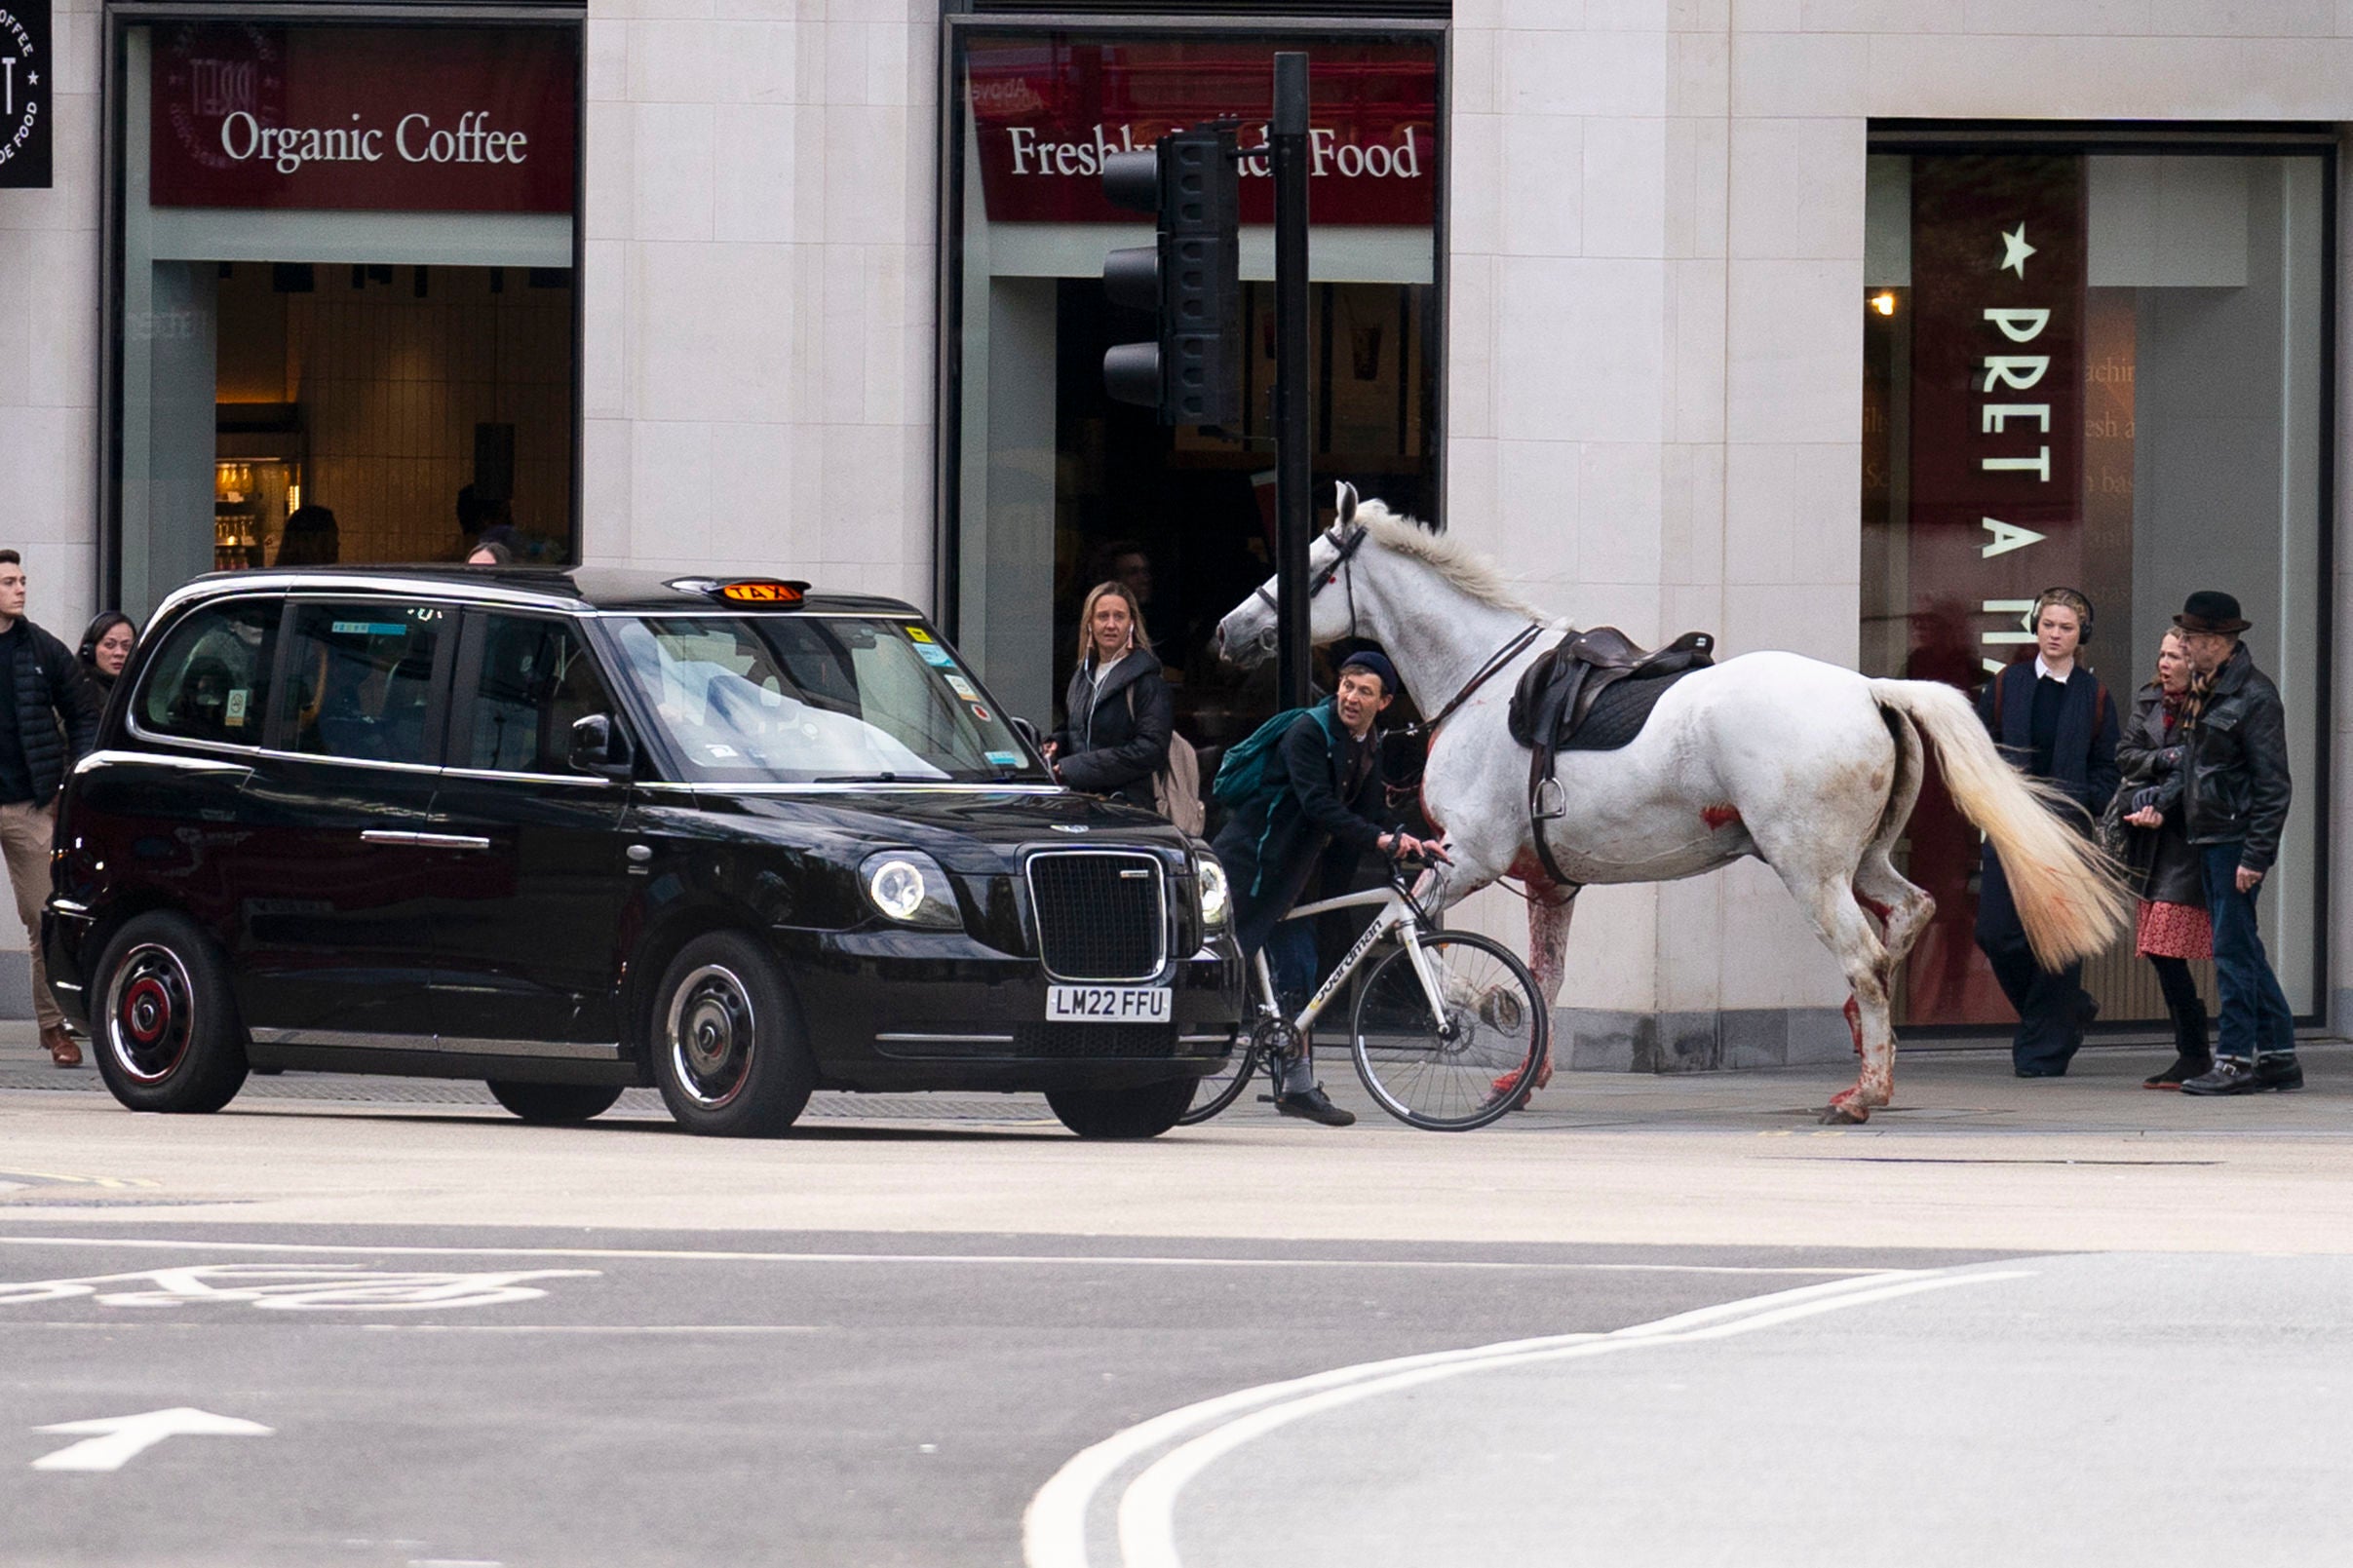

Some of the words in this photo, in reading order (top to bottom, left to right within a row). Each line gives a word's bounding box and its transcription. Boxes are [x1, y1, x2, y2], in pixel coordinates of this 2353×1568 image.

[14, 101, 38, 148] FOOD
[221, 110, 383, 174] Organic
[395, 111, 527, 164] Coffee
[1007, 124, 1157, 176] Freshl
[1309, 127, 1422, 178] Food
[1982, 308, 2051, 482] PRET
[1982, 516, 2048, 558] A
[729, 586, 798, 599] TAXI
[1982, 598, 2039, 675] M
[1056, 989, 1116, 1015] LM22
[1122, 990, 1164, 1016] FFU
